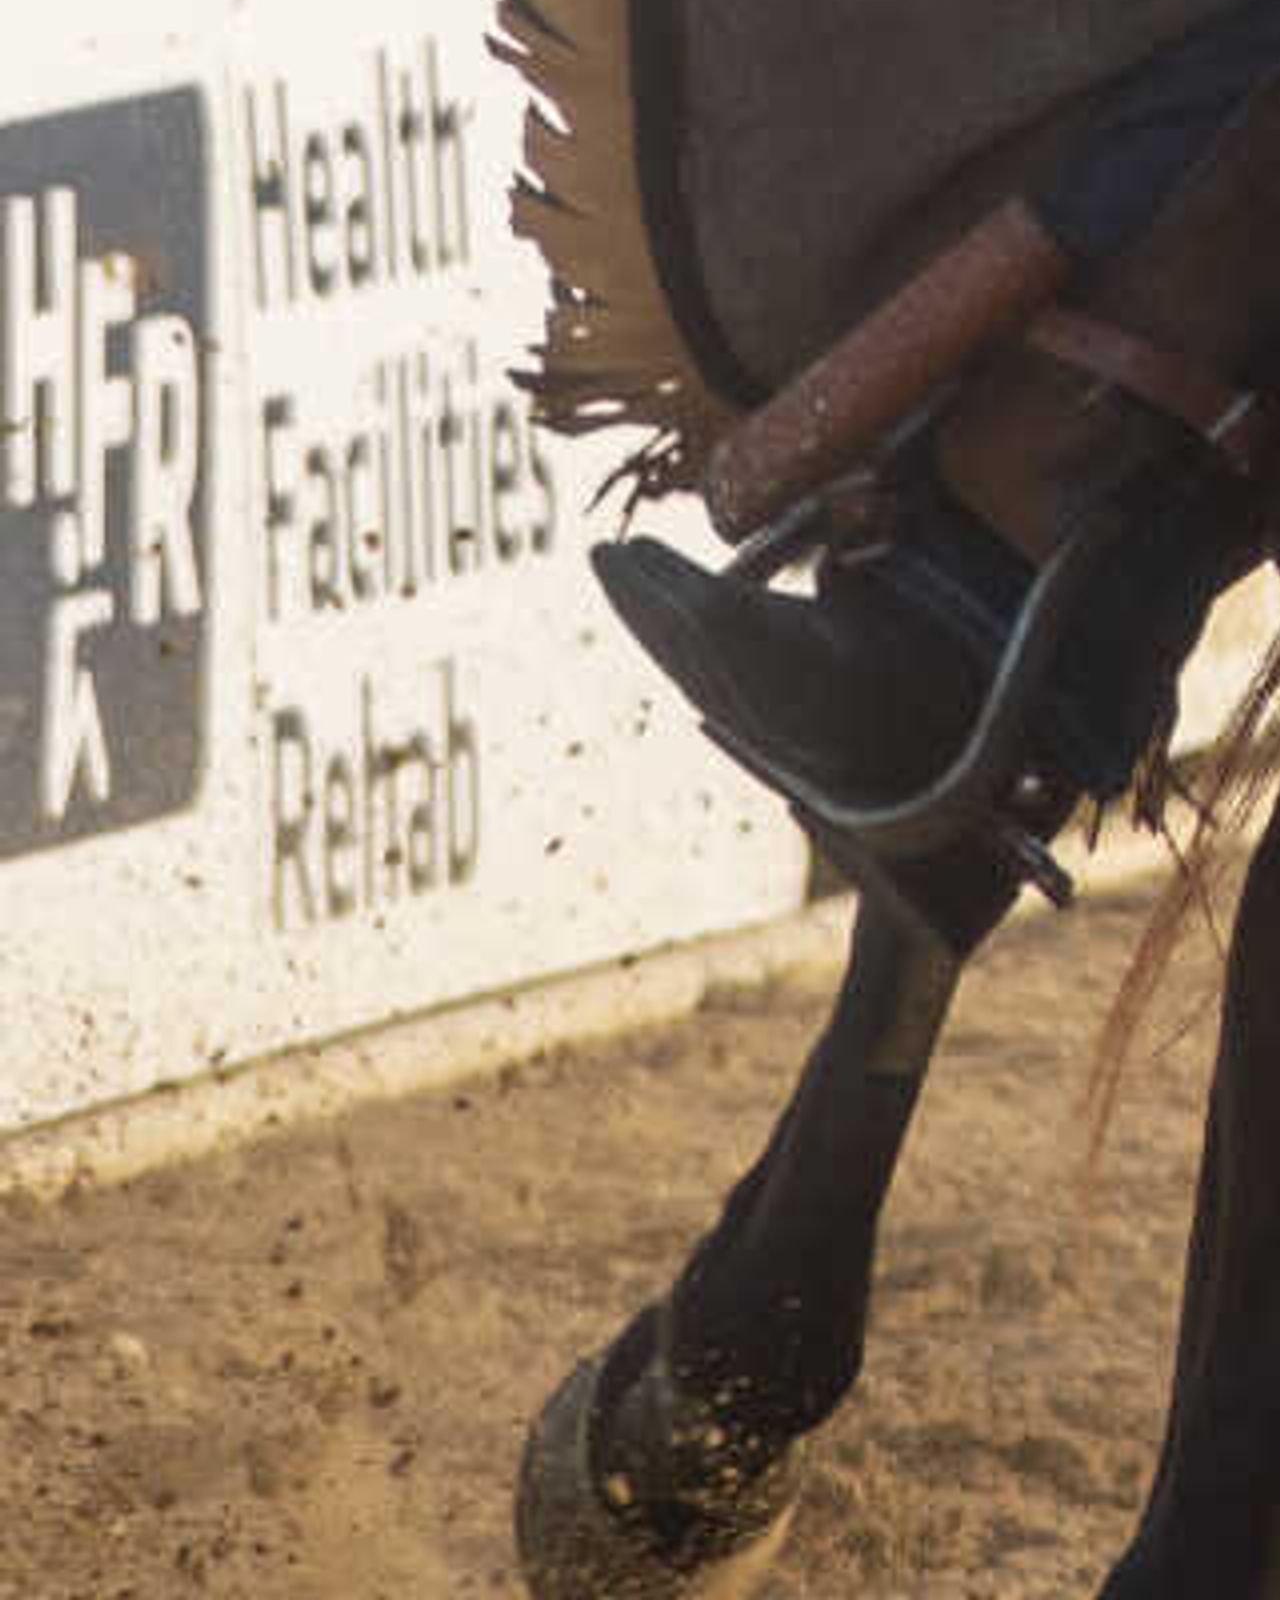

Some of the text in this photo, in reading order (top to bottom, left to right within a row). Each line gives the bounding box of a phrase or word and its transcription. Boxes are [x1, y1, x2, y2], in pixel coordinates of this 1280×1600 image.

[245, 35, 470, 311] Health
[4, 183, 202, 627] HFR
[262, 338, 557, 622] Facilities
[271, 658, 479, 932] Rehab
